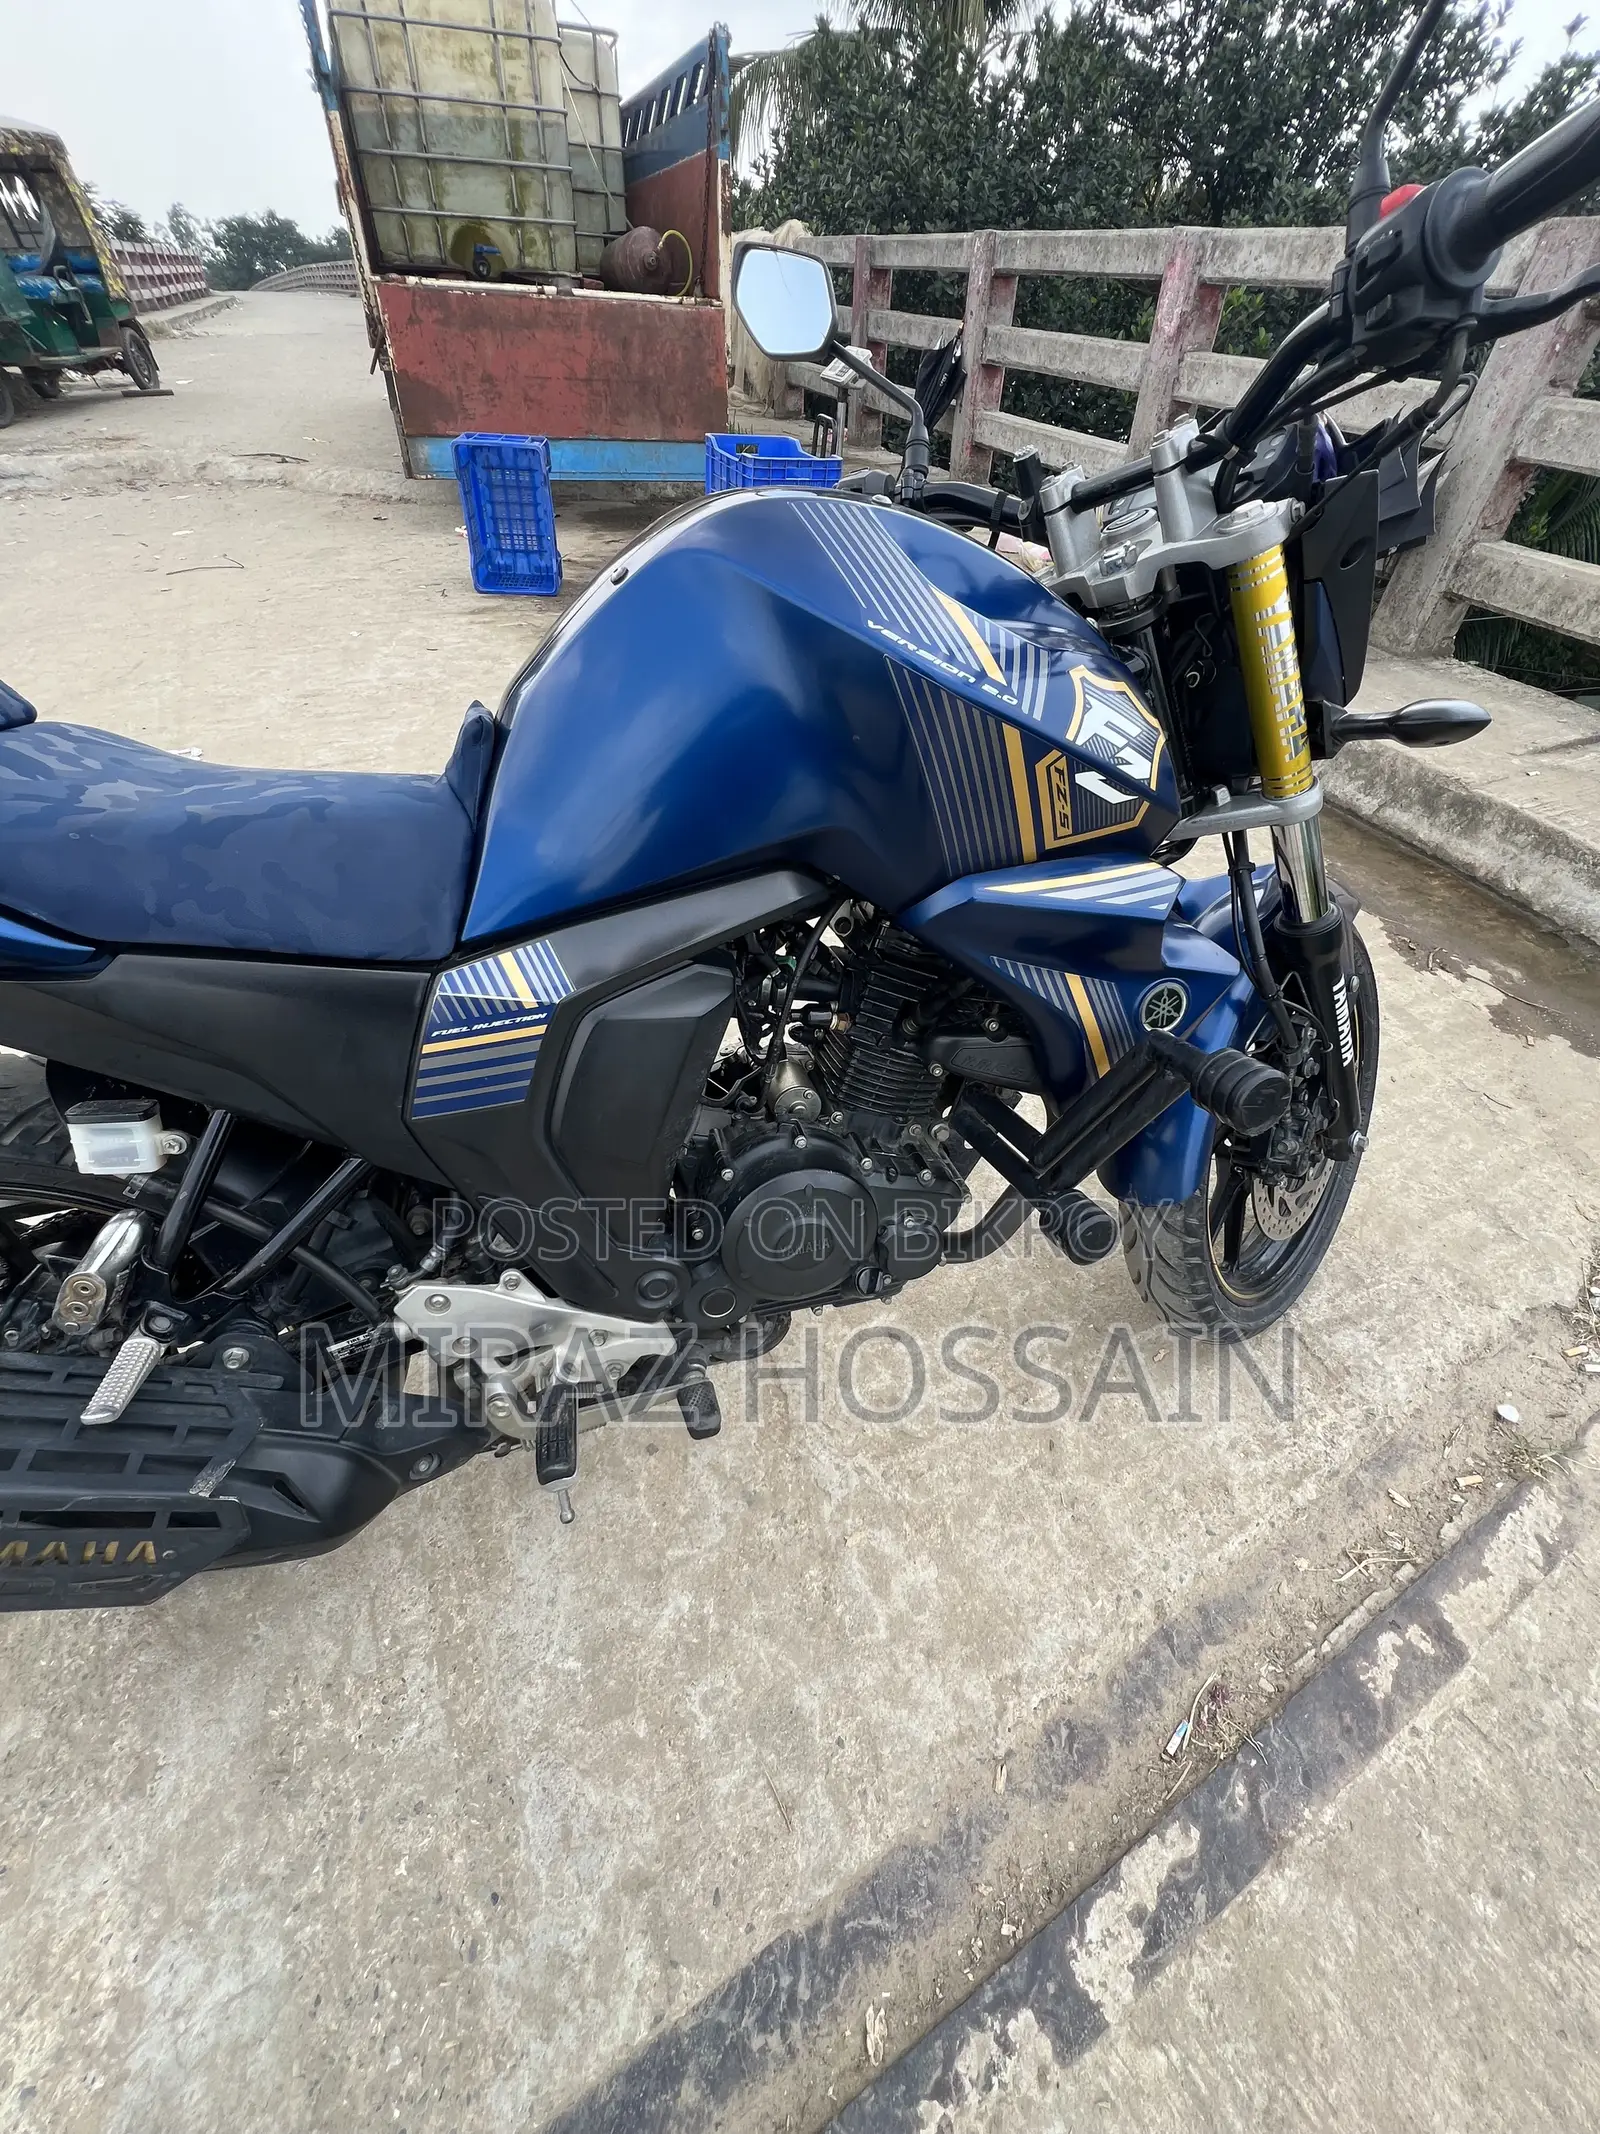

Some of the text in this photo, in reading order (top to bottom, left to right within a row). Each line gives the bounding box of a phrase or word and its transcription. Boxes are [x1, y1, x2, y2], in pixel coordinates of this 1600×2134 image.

[981, 683, 1019, 706] 2.0
[431, 1012, 548, 1037] FUEL INJECTION
